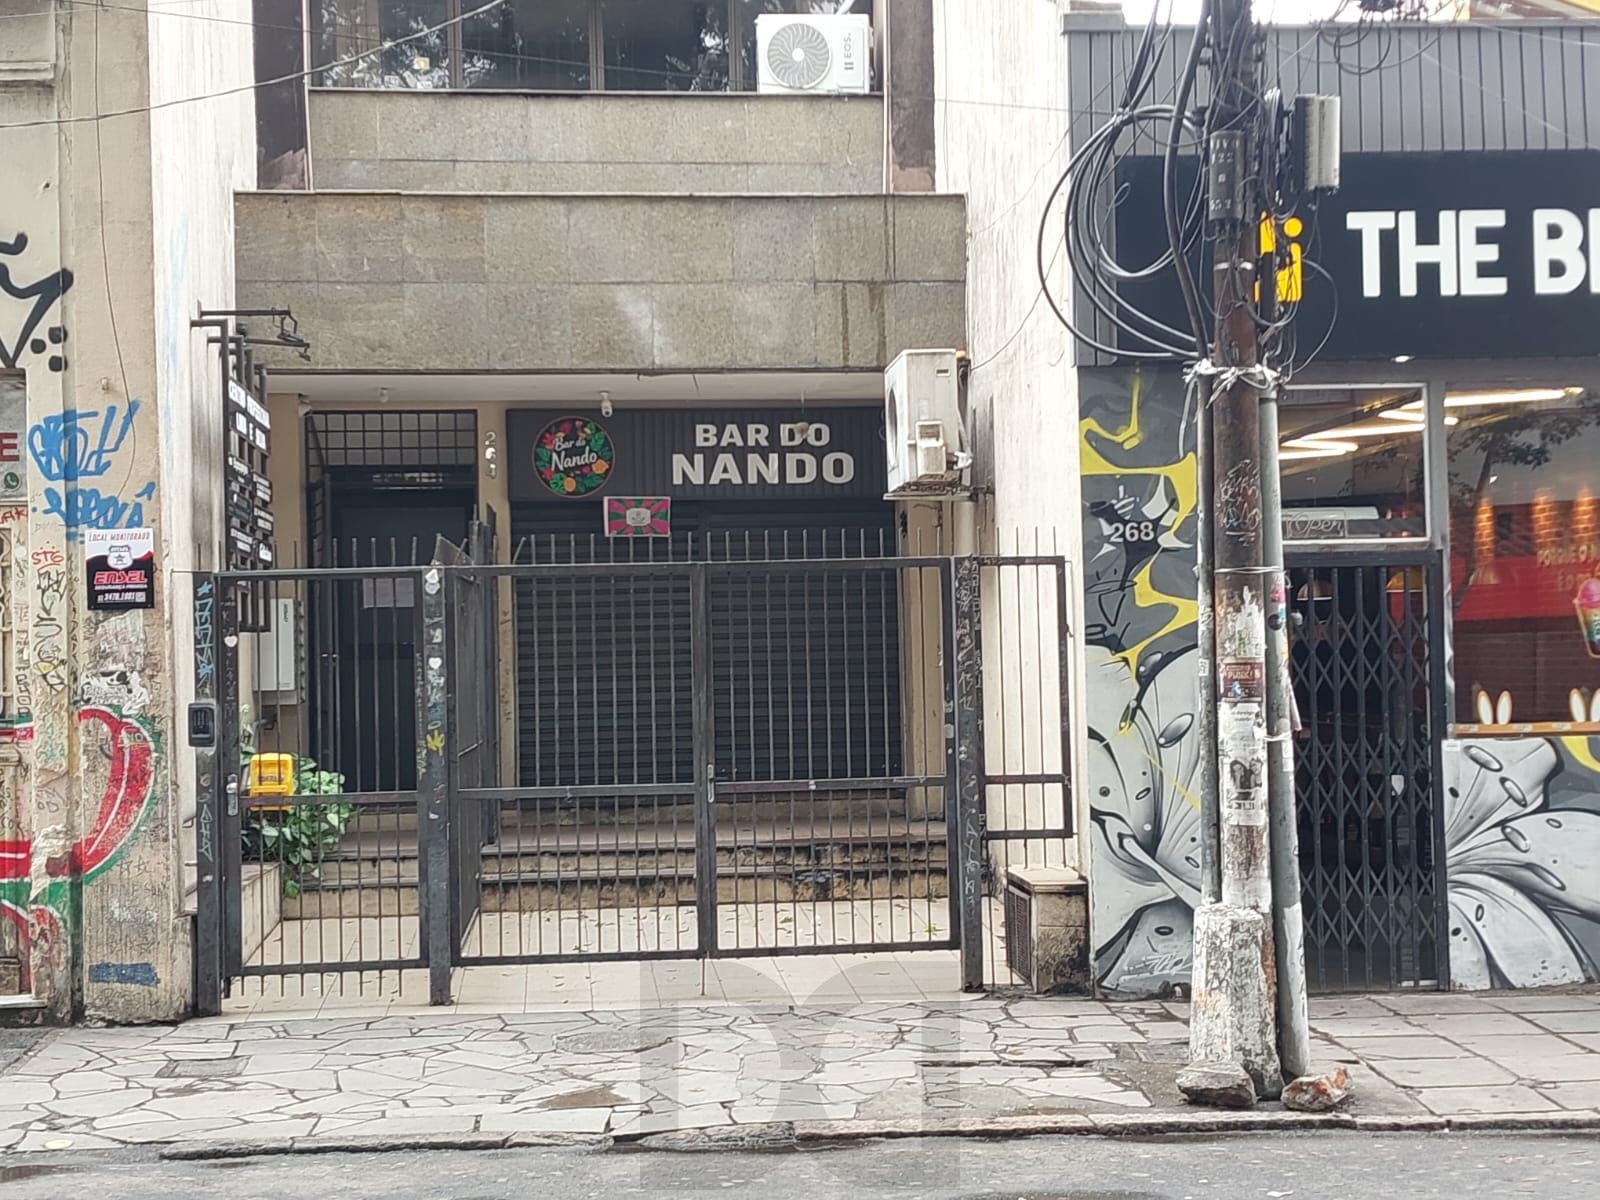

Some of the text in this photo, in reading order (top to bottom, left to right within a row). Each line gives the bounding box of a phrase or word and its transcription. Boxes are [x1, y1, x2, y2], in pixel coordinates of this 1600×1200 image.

[1346, 208, 1600, 298] THE B
[554, 437, 575, 451] Bar
[695, 422, 831, 447] BAR DO
[551, 446, 597, 471] Nando
[672, 452, 855, 485] NANDO
[1110, 522, 1155, 542] 268
[1290, 512, 1344, 538] Open
